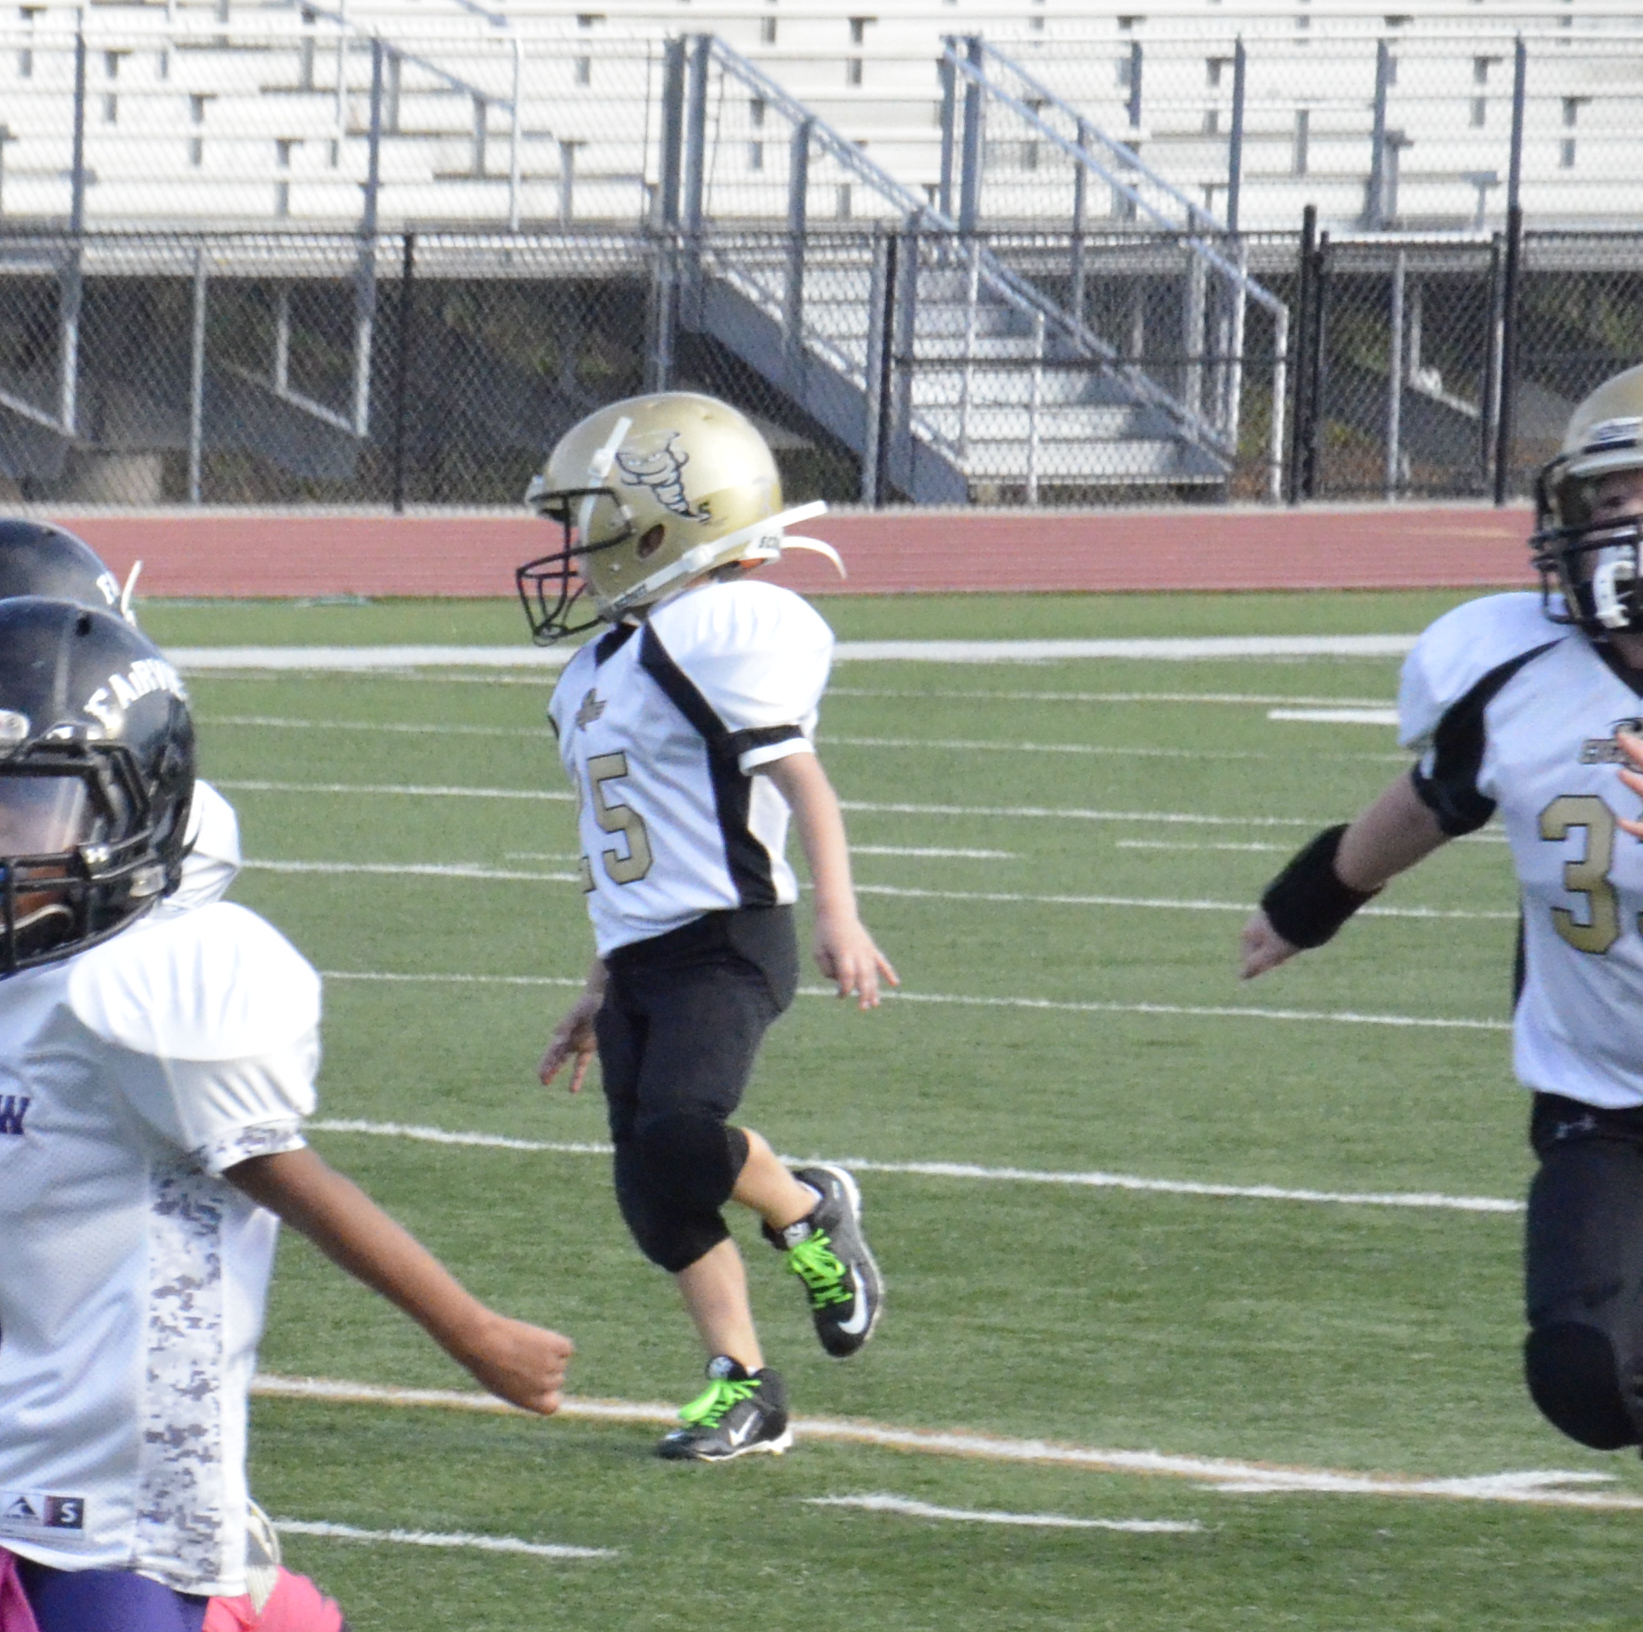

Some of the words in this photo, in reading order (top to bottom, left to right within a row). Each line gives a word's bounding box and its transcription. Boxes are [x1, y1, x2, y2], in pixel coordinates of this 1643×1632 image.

[579, 751, 653, 893] 5
[1538, 794, 1643, 955] 3
[60, 1502, 77, 1523] S
